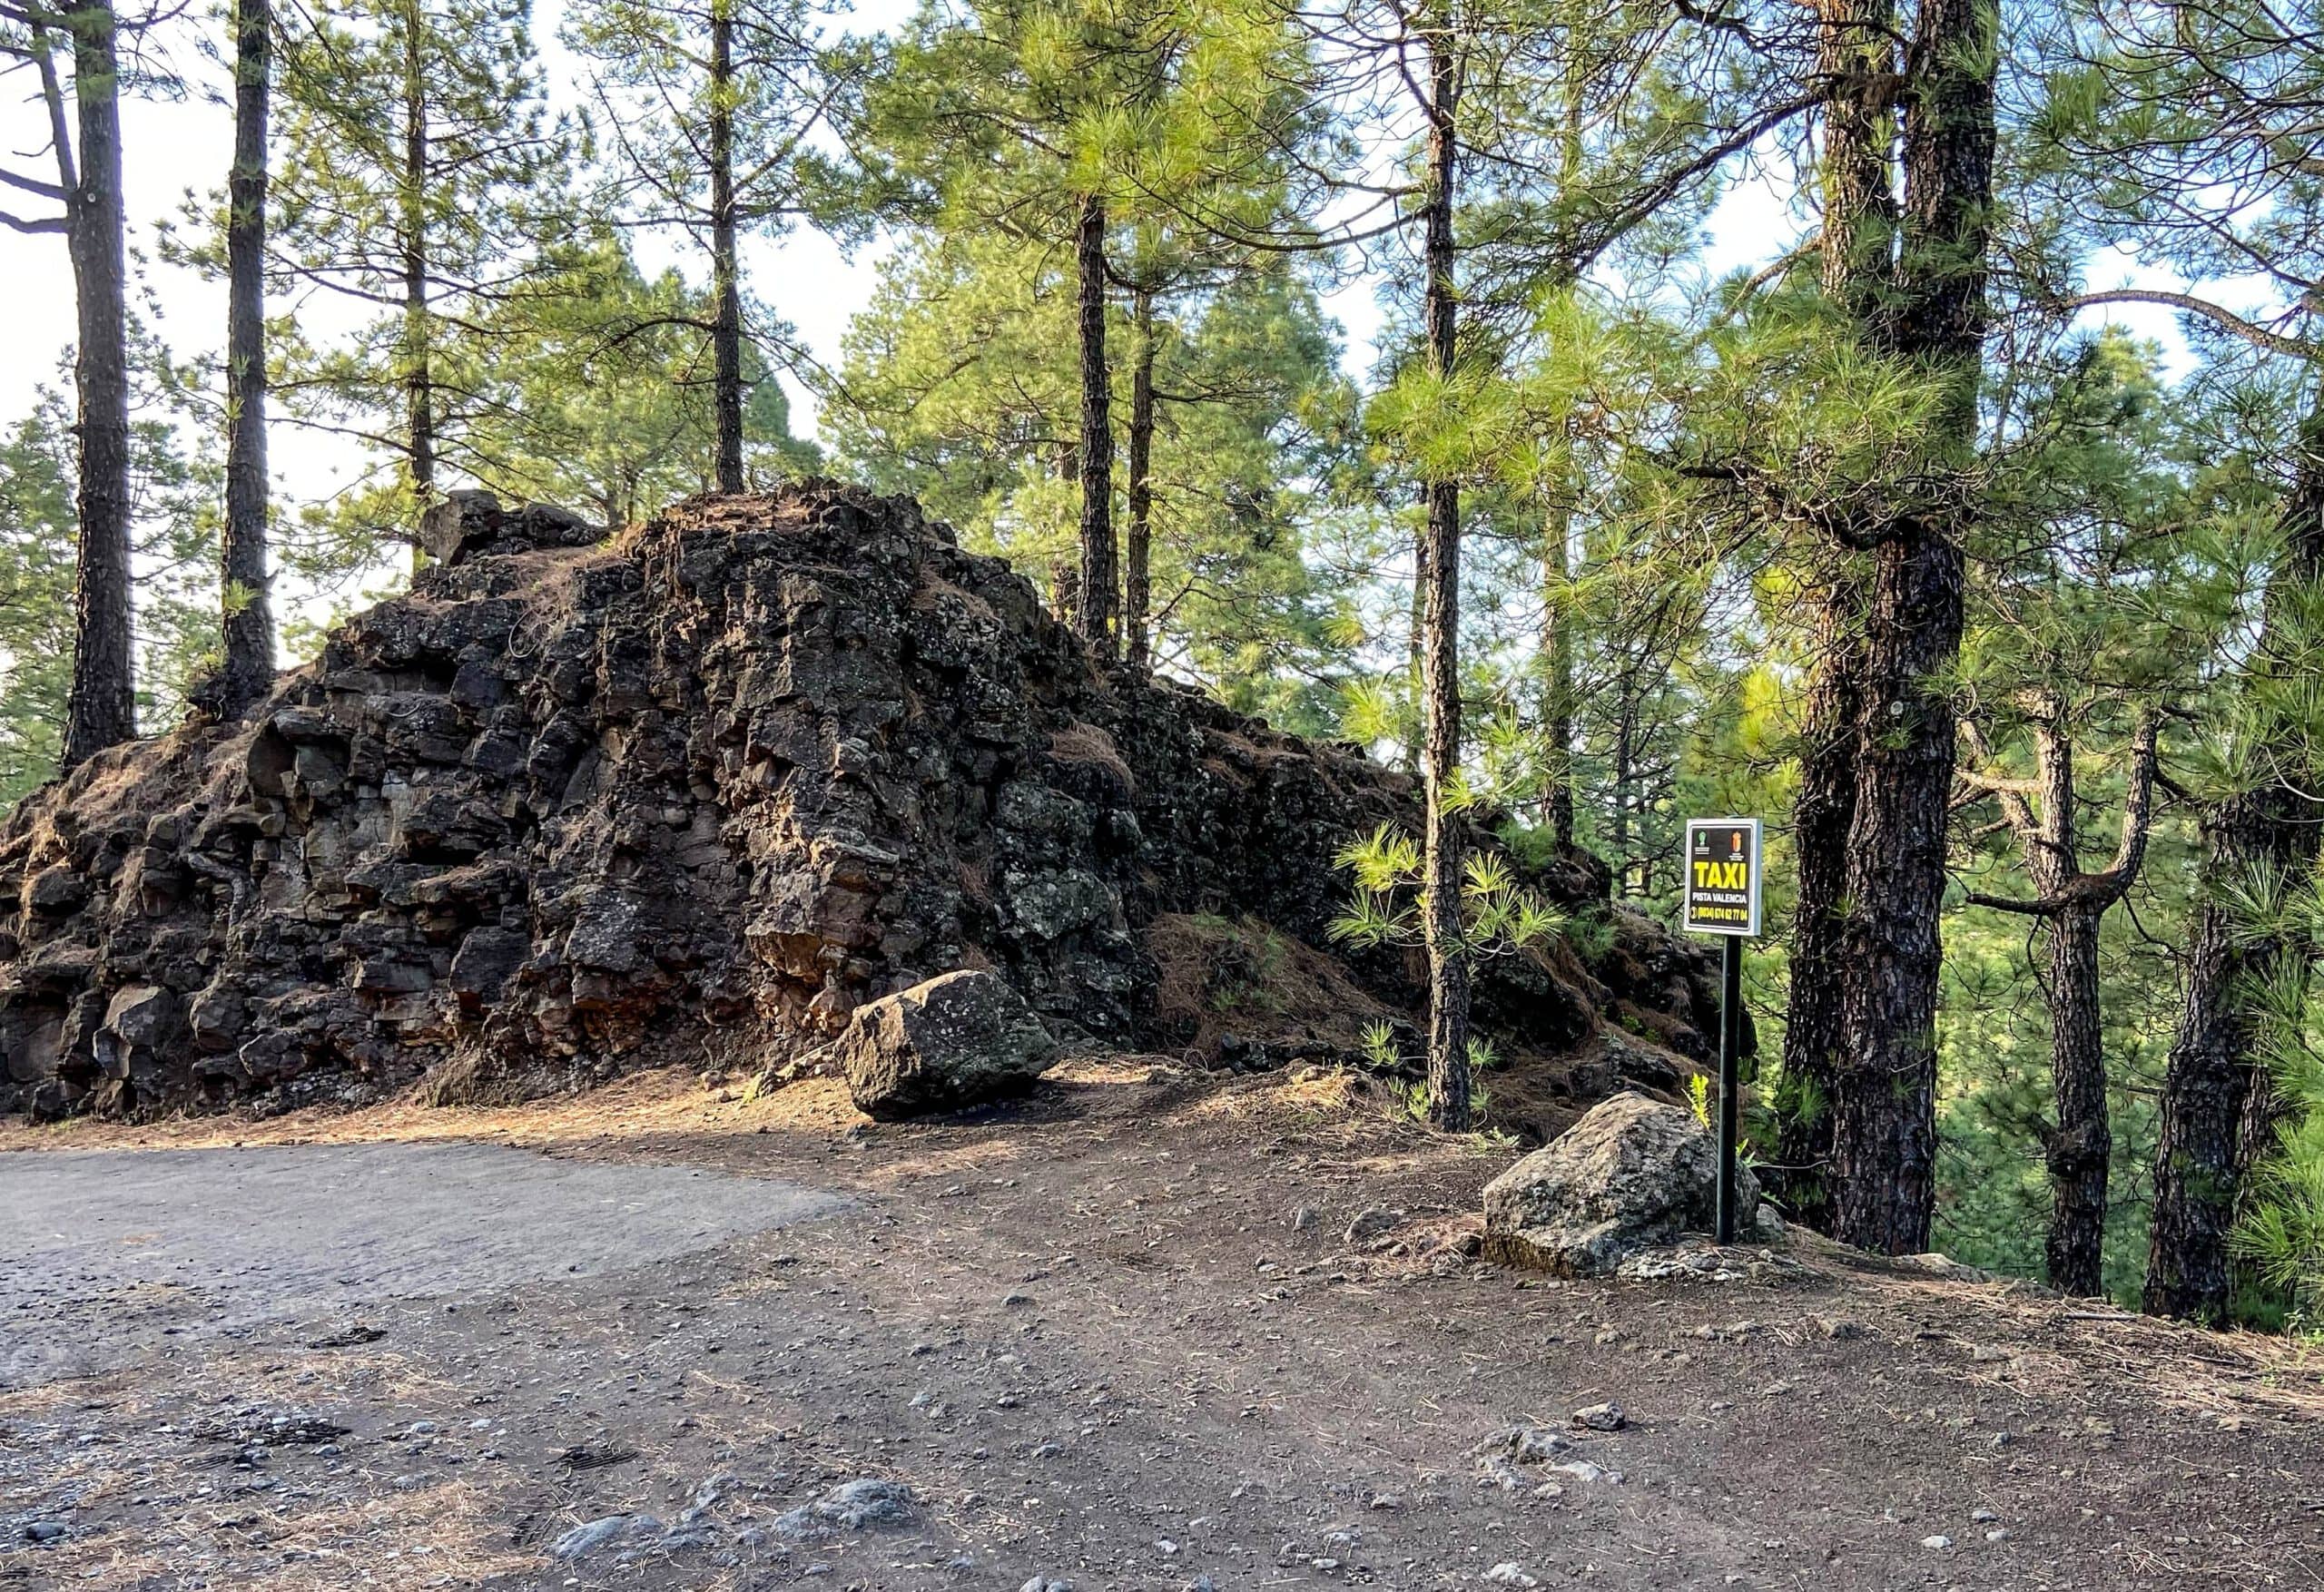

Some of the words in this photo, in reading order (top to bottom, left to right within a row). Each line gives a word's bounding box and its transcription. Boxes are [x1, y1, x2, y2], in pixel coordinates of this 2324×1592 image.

[1694, 861, 1746, 889] TAXI
[1692, 892, 1712, 901] PISTA
[1712, 892, 1748, 904] VALENCIA
[1732, 909, 1740, 920] 77
